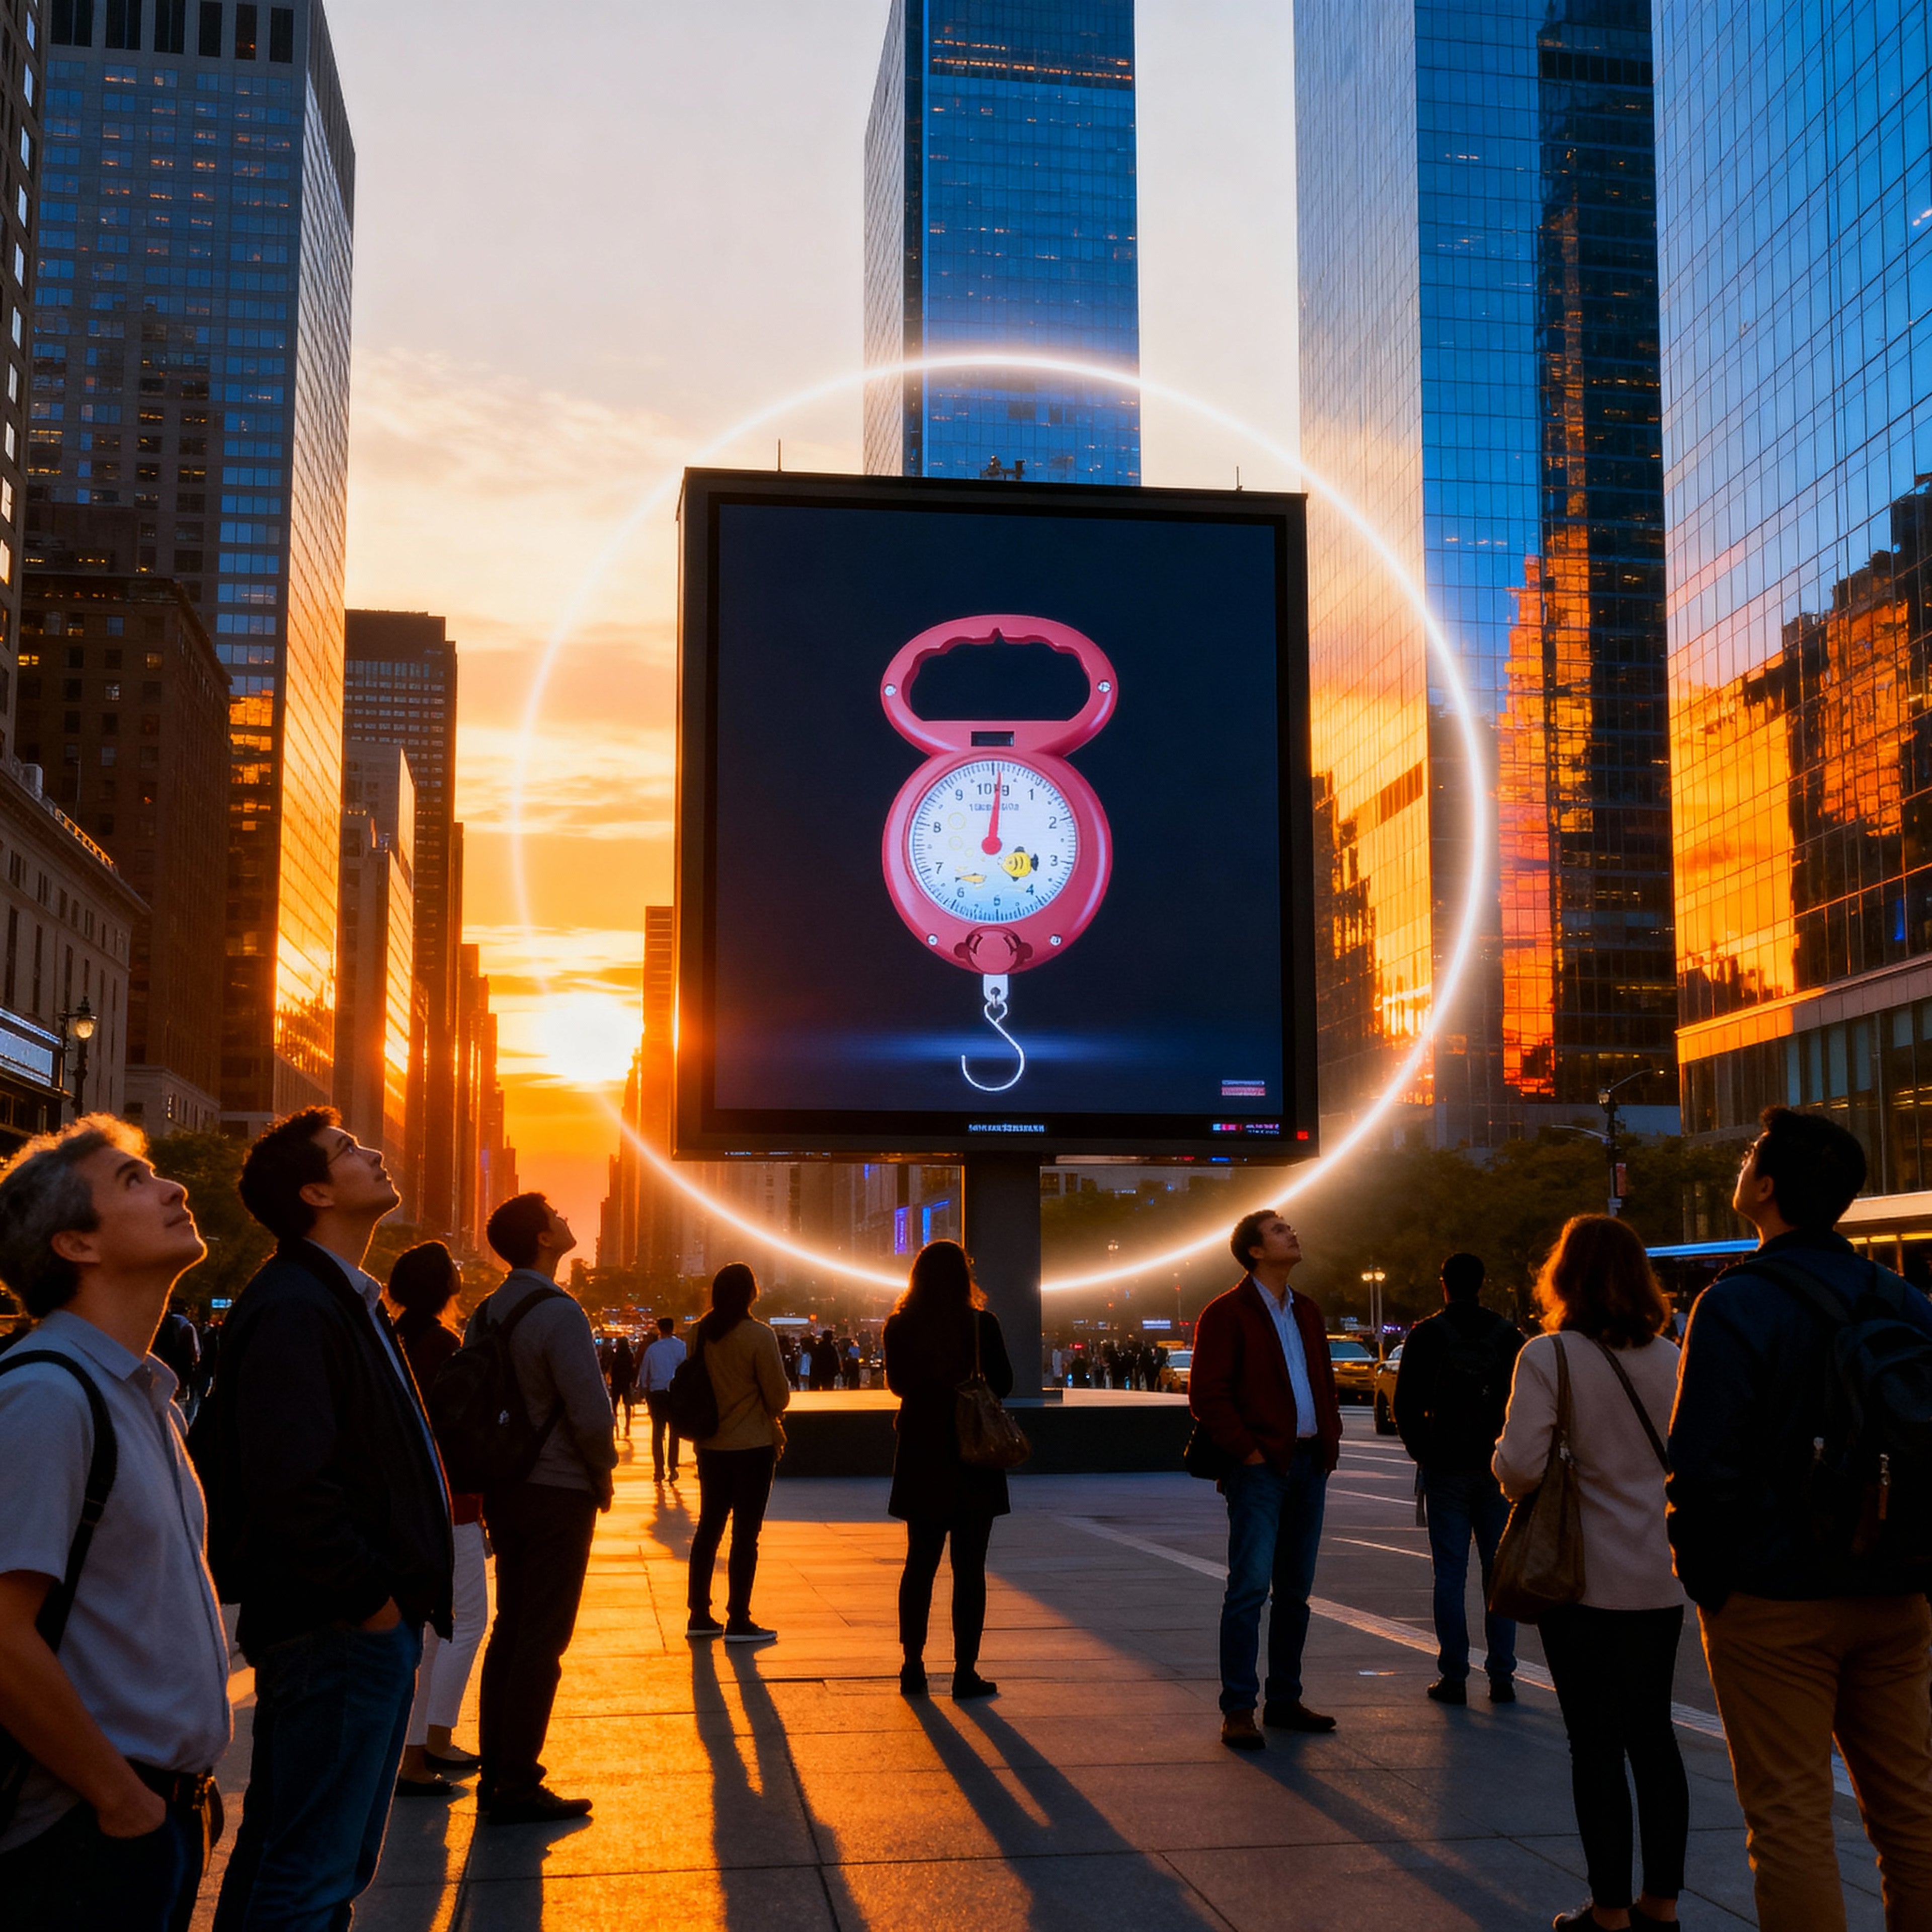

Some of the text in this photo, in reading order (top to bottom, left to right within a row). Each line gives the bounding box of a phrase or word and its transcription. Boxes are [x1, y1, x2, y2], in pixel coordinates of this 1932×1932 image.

[955, 789, 963, 801] 9
[1028, 788, 1034, 800] 1
[933, 822, 942, 833] 8
[1049, 816, 1057, 829] 2
[1050, 855, 1058, 866] 3
[935, 862, 944, 874] 7
[957, 887, 965, 898] 6
[1025, 883, 1034, 896] 4
